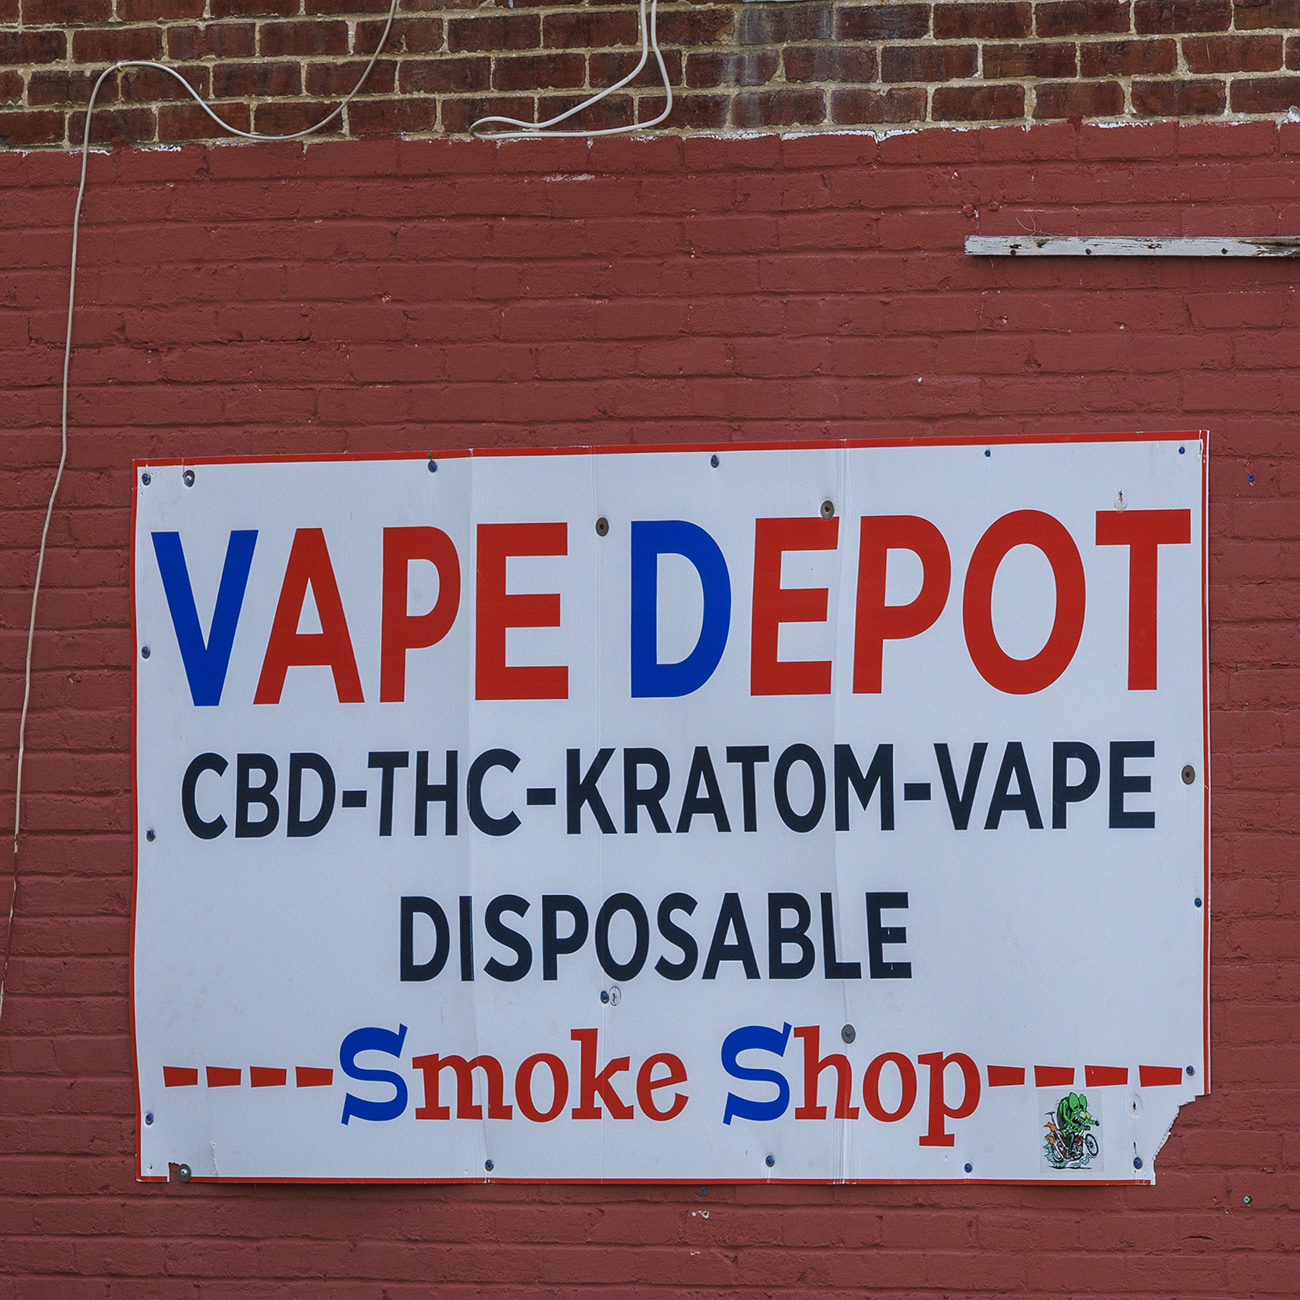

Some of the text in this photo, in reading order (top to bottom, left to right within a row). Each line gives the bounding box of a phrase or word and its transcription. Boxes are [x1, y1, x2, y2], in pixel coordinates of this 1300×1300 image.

[152, 509, 1191, 706] VAPE DEPOT
[181, 740, 1156, 840] CBD-THC-KRATOM-VAPE
[401, 891, 912, 982] DISPOSABLE
